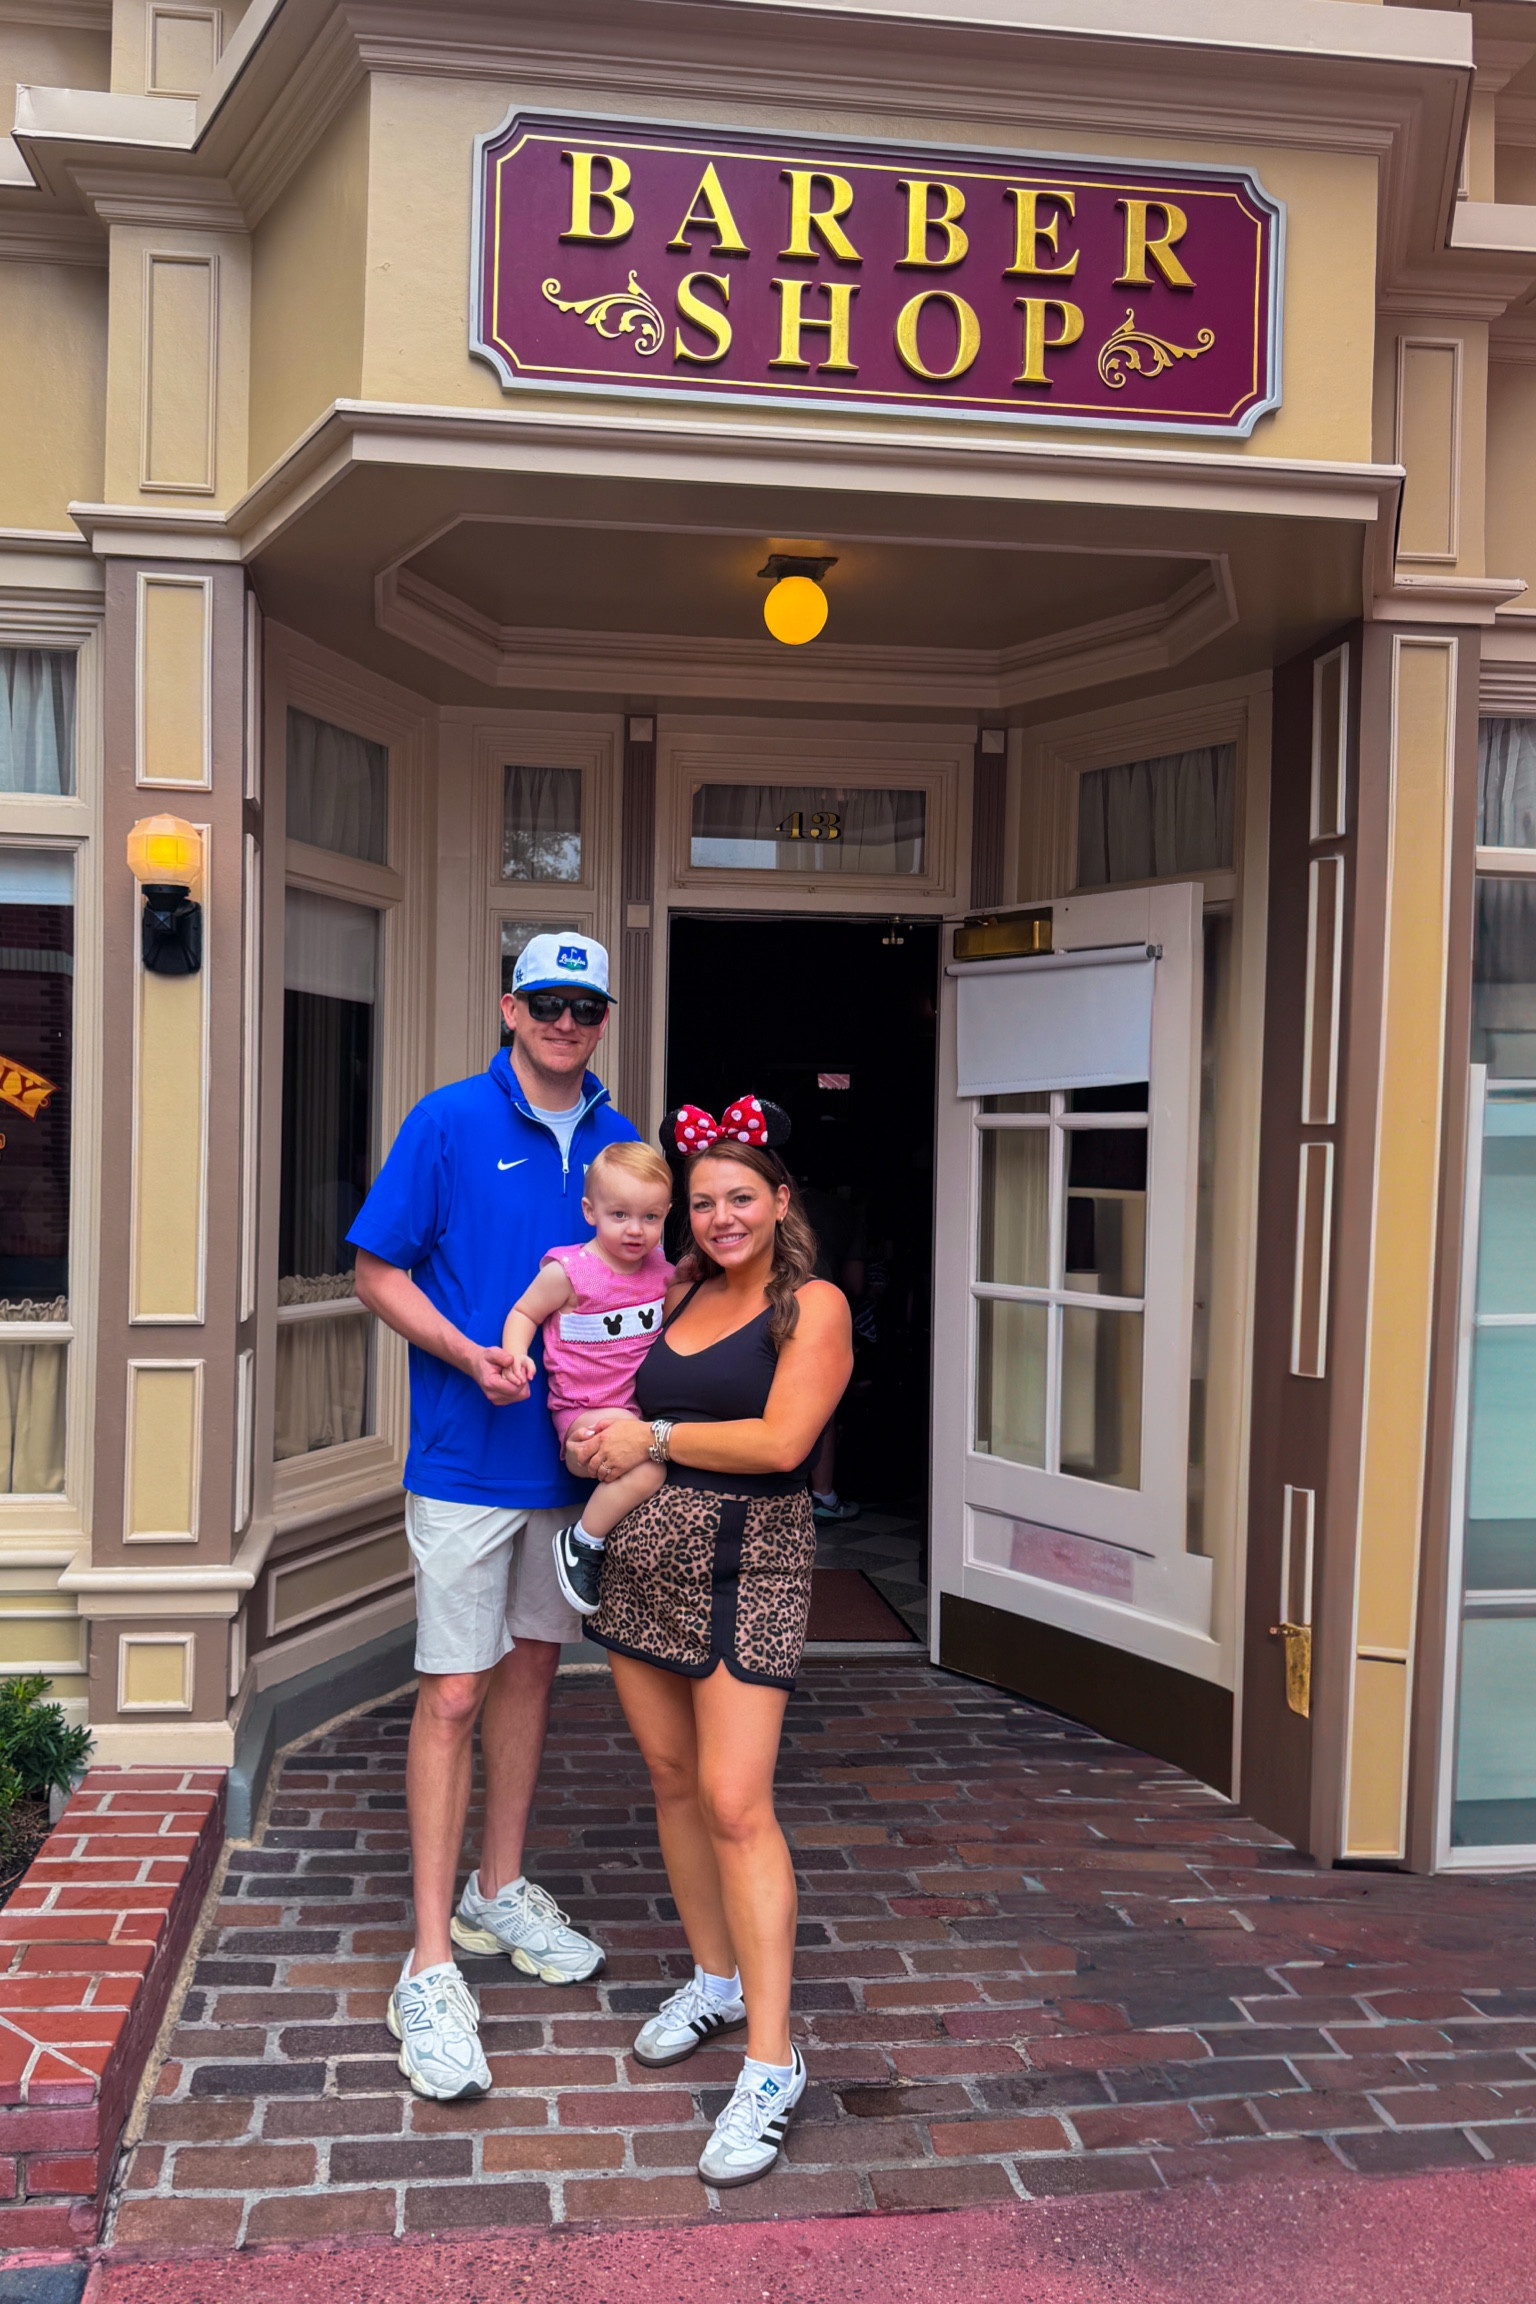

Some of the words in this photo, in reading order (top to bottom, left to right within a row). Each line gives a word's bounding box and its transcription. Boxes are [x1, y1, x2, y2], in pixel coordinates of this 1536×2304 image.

[559, 150, 1197, 291] BARBER
[673, 271, 1086, 385] SHOP
[775, 811, 841, 840] 43
